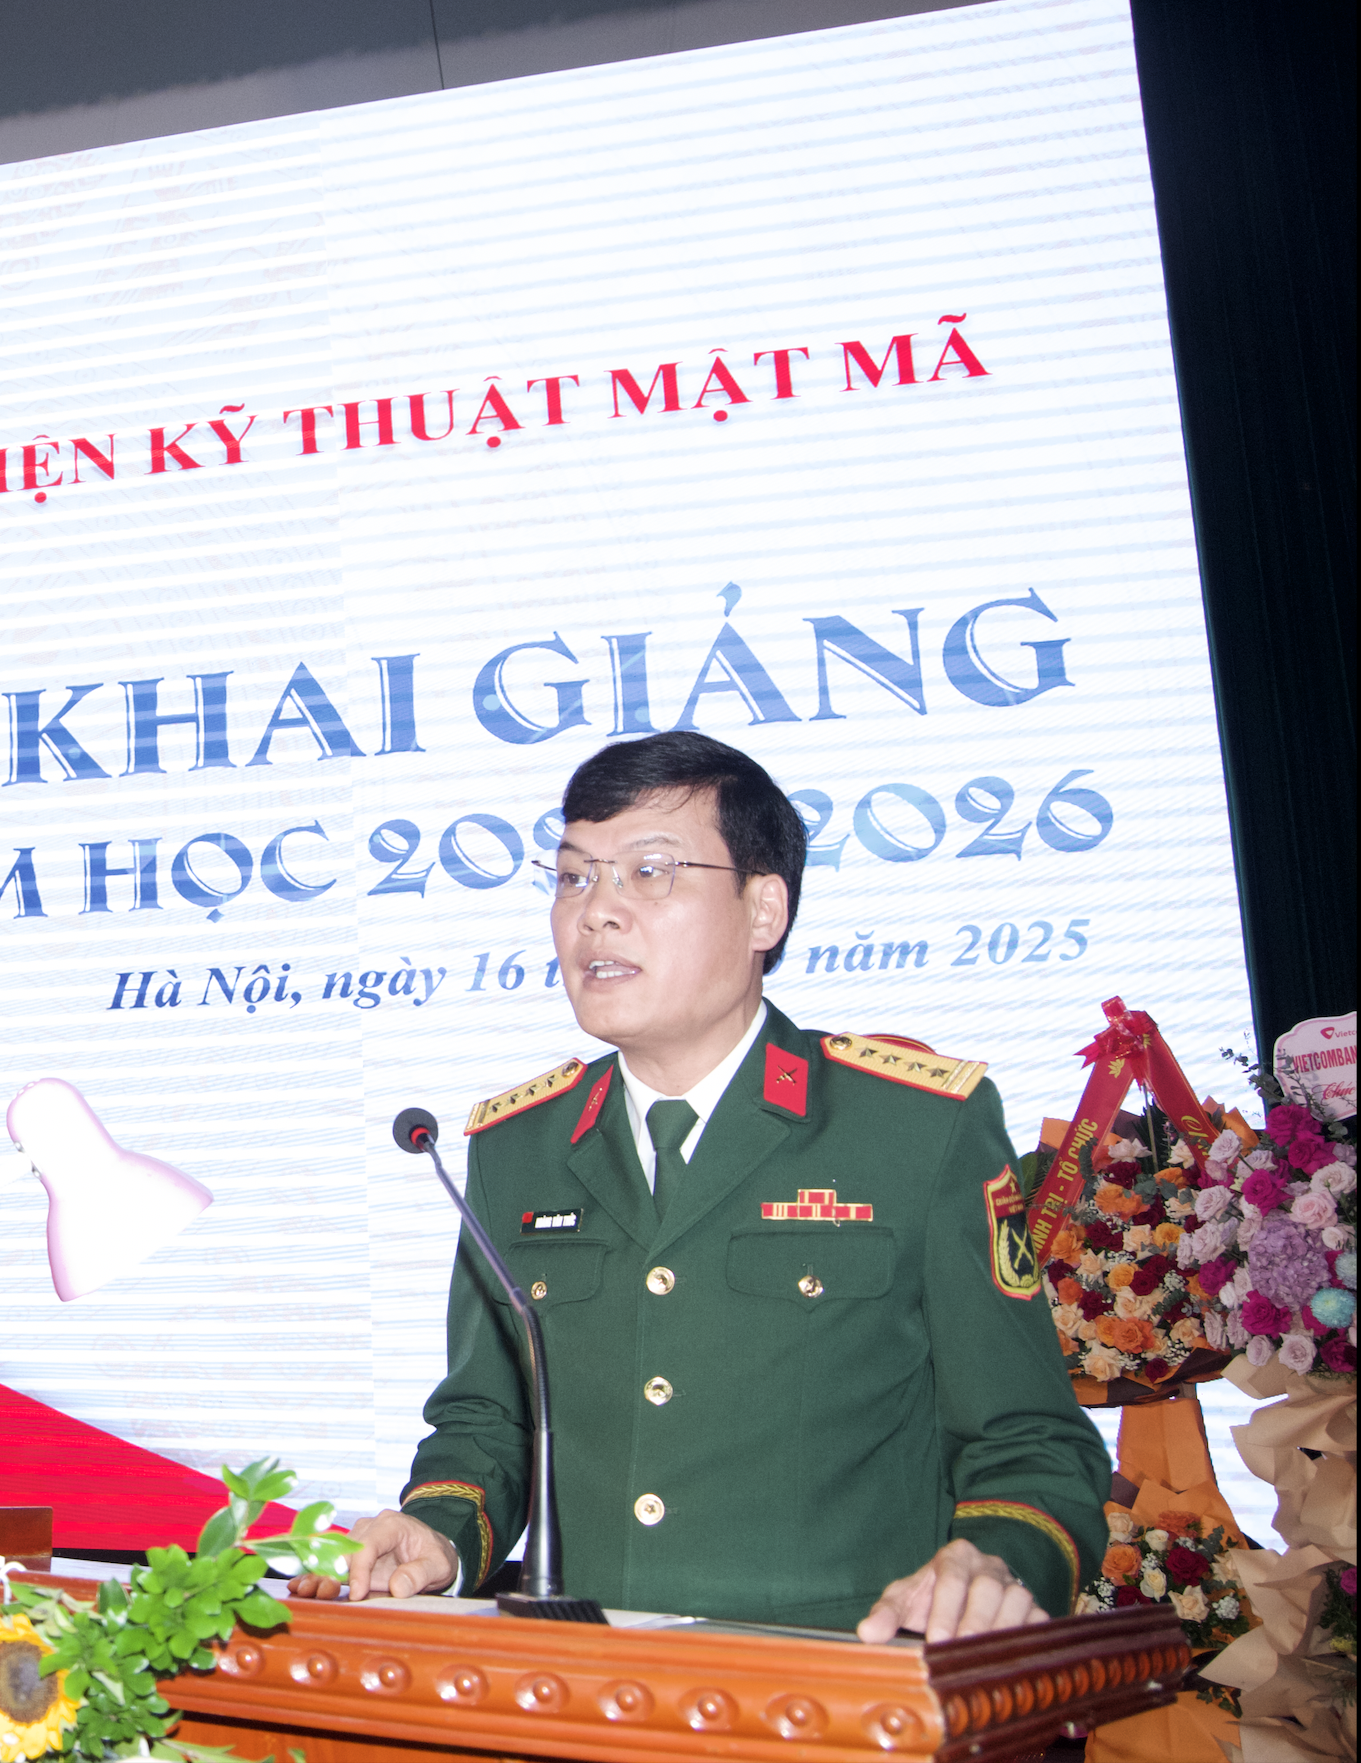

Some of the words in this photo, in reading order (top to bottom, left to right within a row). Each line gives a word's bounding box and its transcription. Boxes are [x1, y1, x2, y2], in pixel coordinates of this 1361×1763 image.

[143, 402, 259, 477] KỸ
[283, 375, 581, 457] THUẬT
[603, 347, 811, 424] MẬT
[835, 312, 994, 393] MÃ
[1, 653, 426, 788] KHAI
[472, 581, 1076, 746] GIẢNG
[78, 819, 338, 924] HỌC
[805, 930, 929, 974] năm
[950, 919, 1091, 966] 2025
[106, 967, 183, 1010] Hà
[197, 963, 303, 1014] Nội,
[321, 956, 448, 1010] ngày
[464, 949, 528, 993] 16
[1293, 1045, 1357, 1074] VIETCOMBAN
[1057, 1157, 1078, 1182] TỔ
